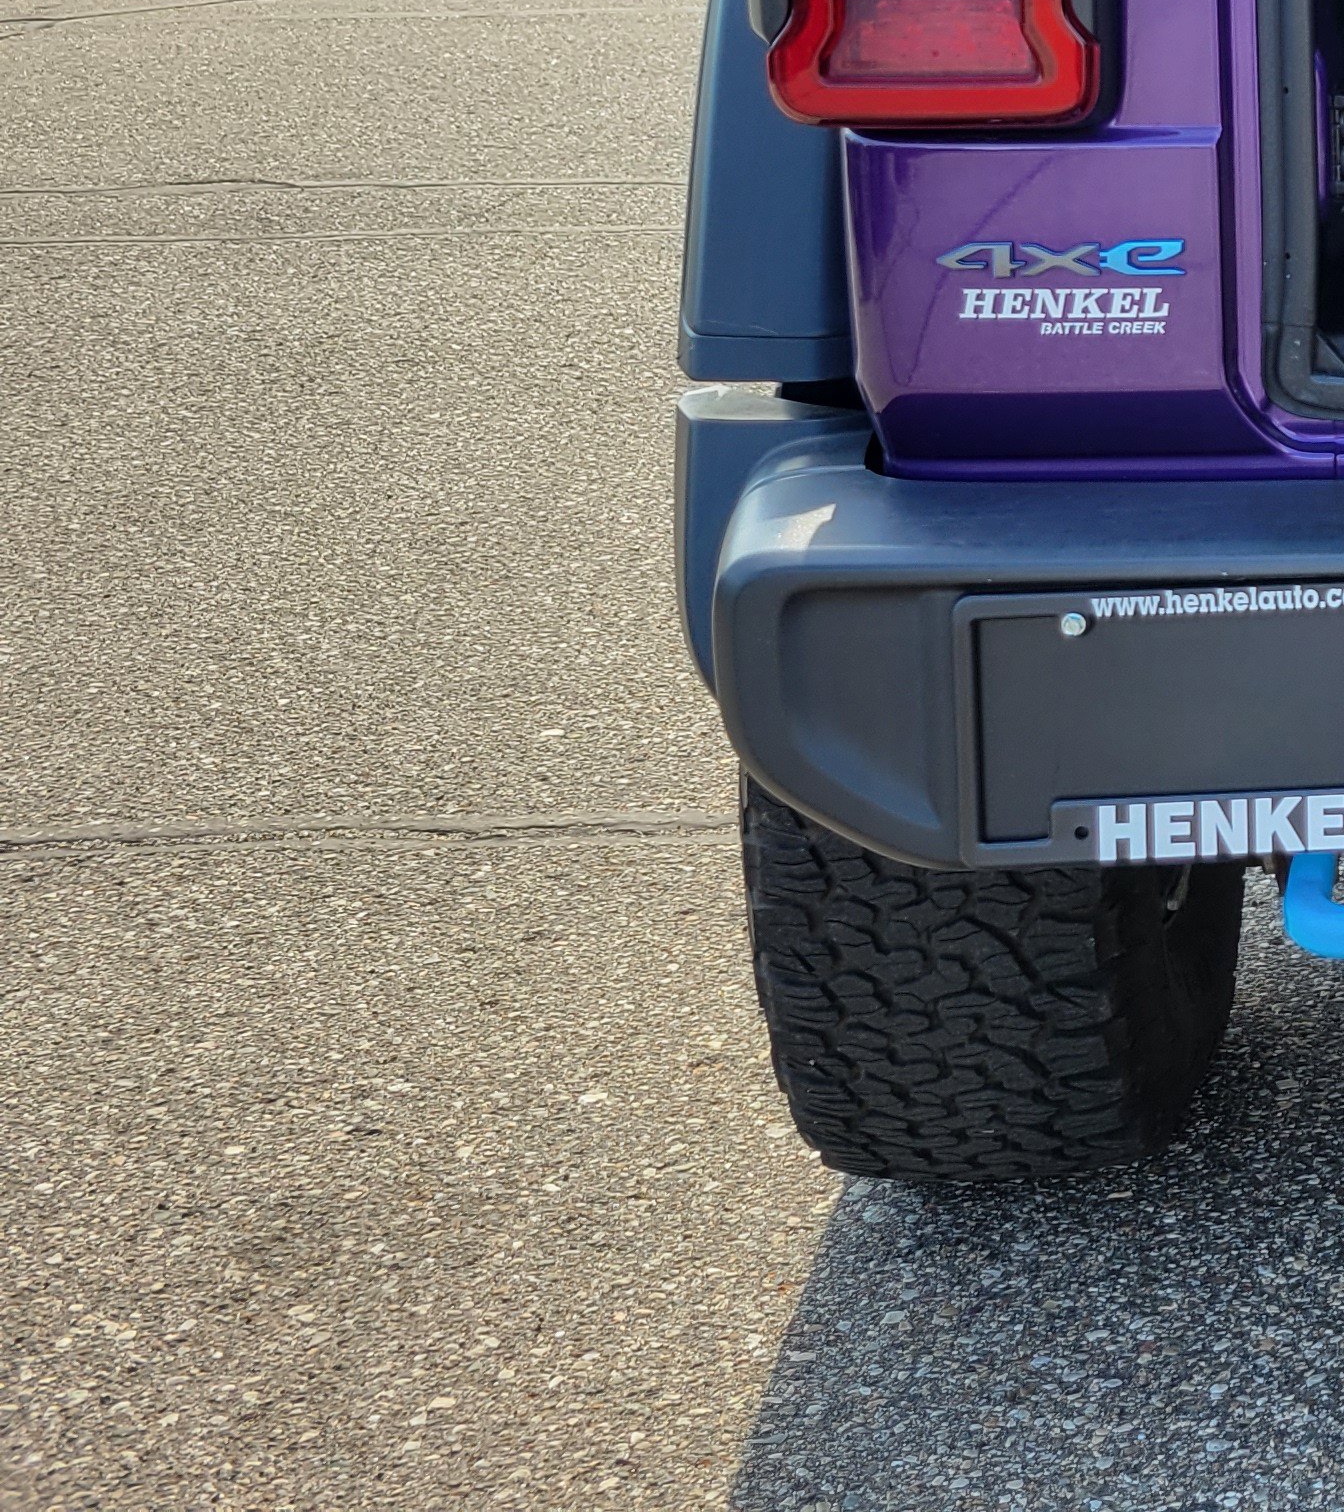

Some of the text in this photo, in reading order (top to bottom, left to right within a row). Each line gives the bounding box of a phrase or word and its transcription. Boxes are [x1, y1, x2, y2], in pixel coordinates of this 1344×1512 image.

[959, 287, 1170, 320] HENKEL
[1040, 321, 1167, 336] BATTLE CREEK
